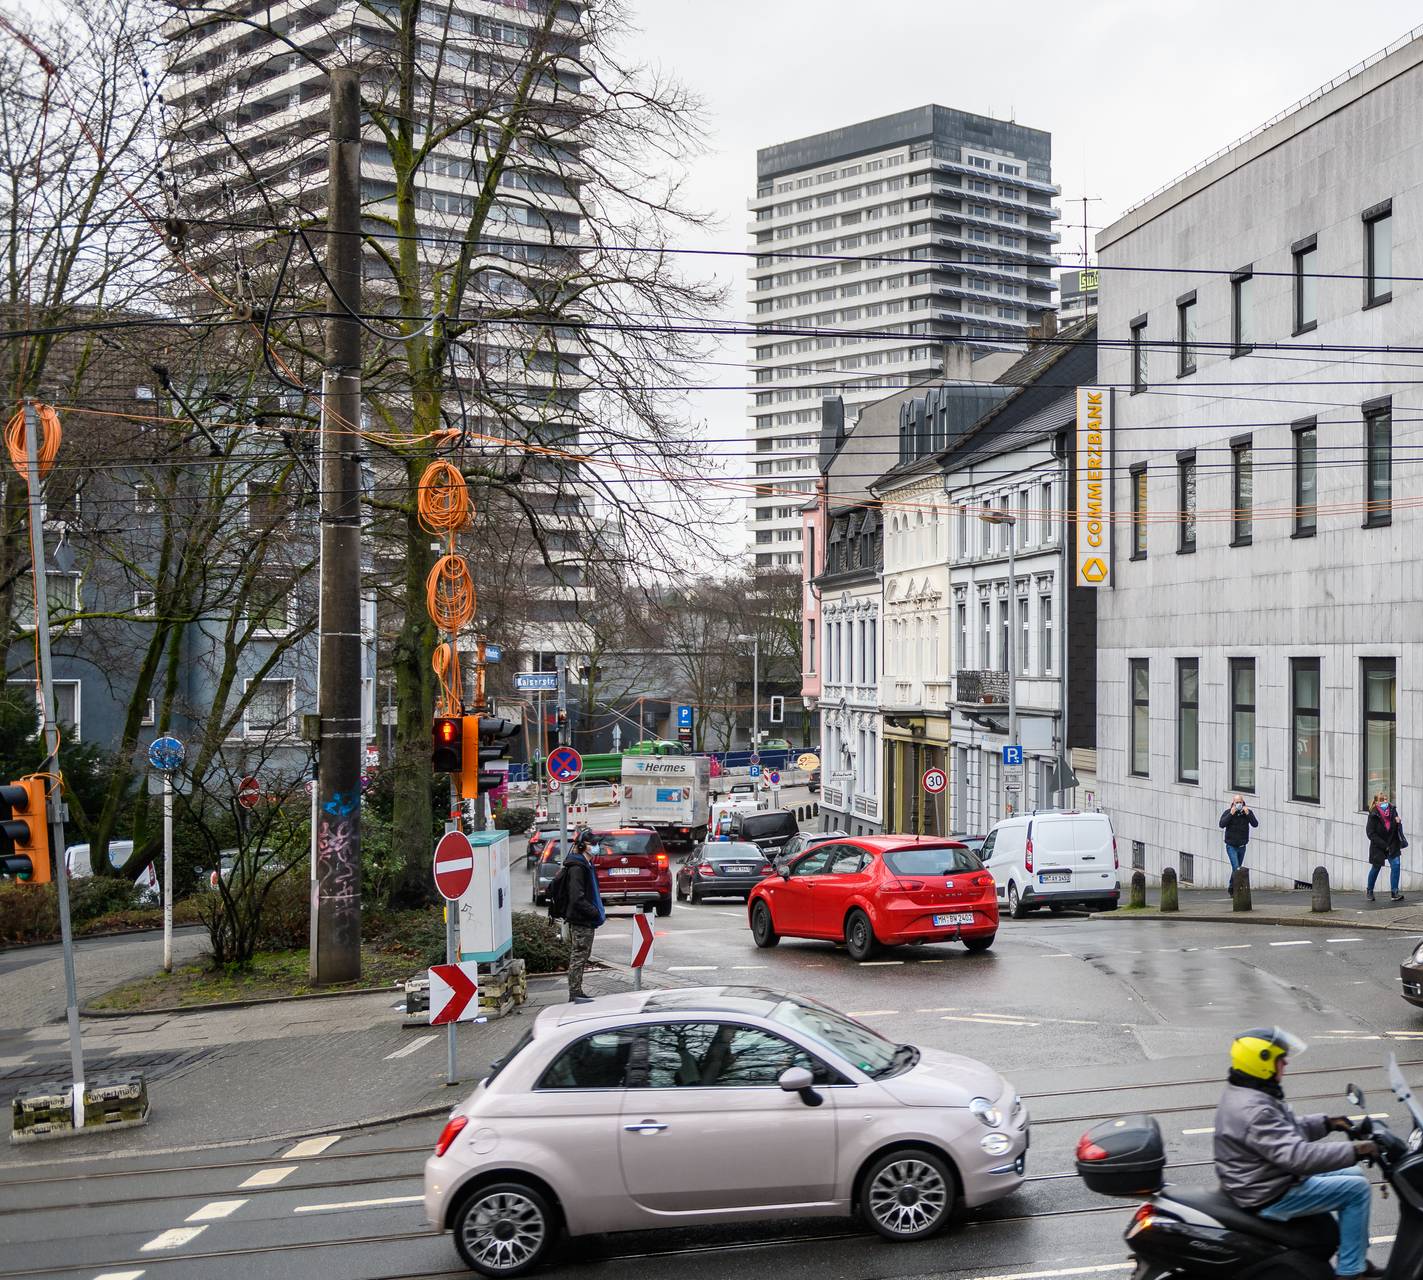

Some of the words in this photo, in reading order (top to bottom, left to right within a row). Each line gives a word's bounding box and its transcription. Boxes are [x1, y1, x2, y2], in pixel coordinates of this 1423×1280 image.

[1087, 391, 1103, 548] COMMERZBANK
[682, 709, 689, 718] P
[1007, 748, 1019, 763] P
[645, 763, 686, 772] Hermes
[751, 767, 758, 776] P
[927, 775, 943, 787] 30
